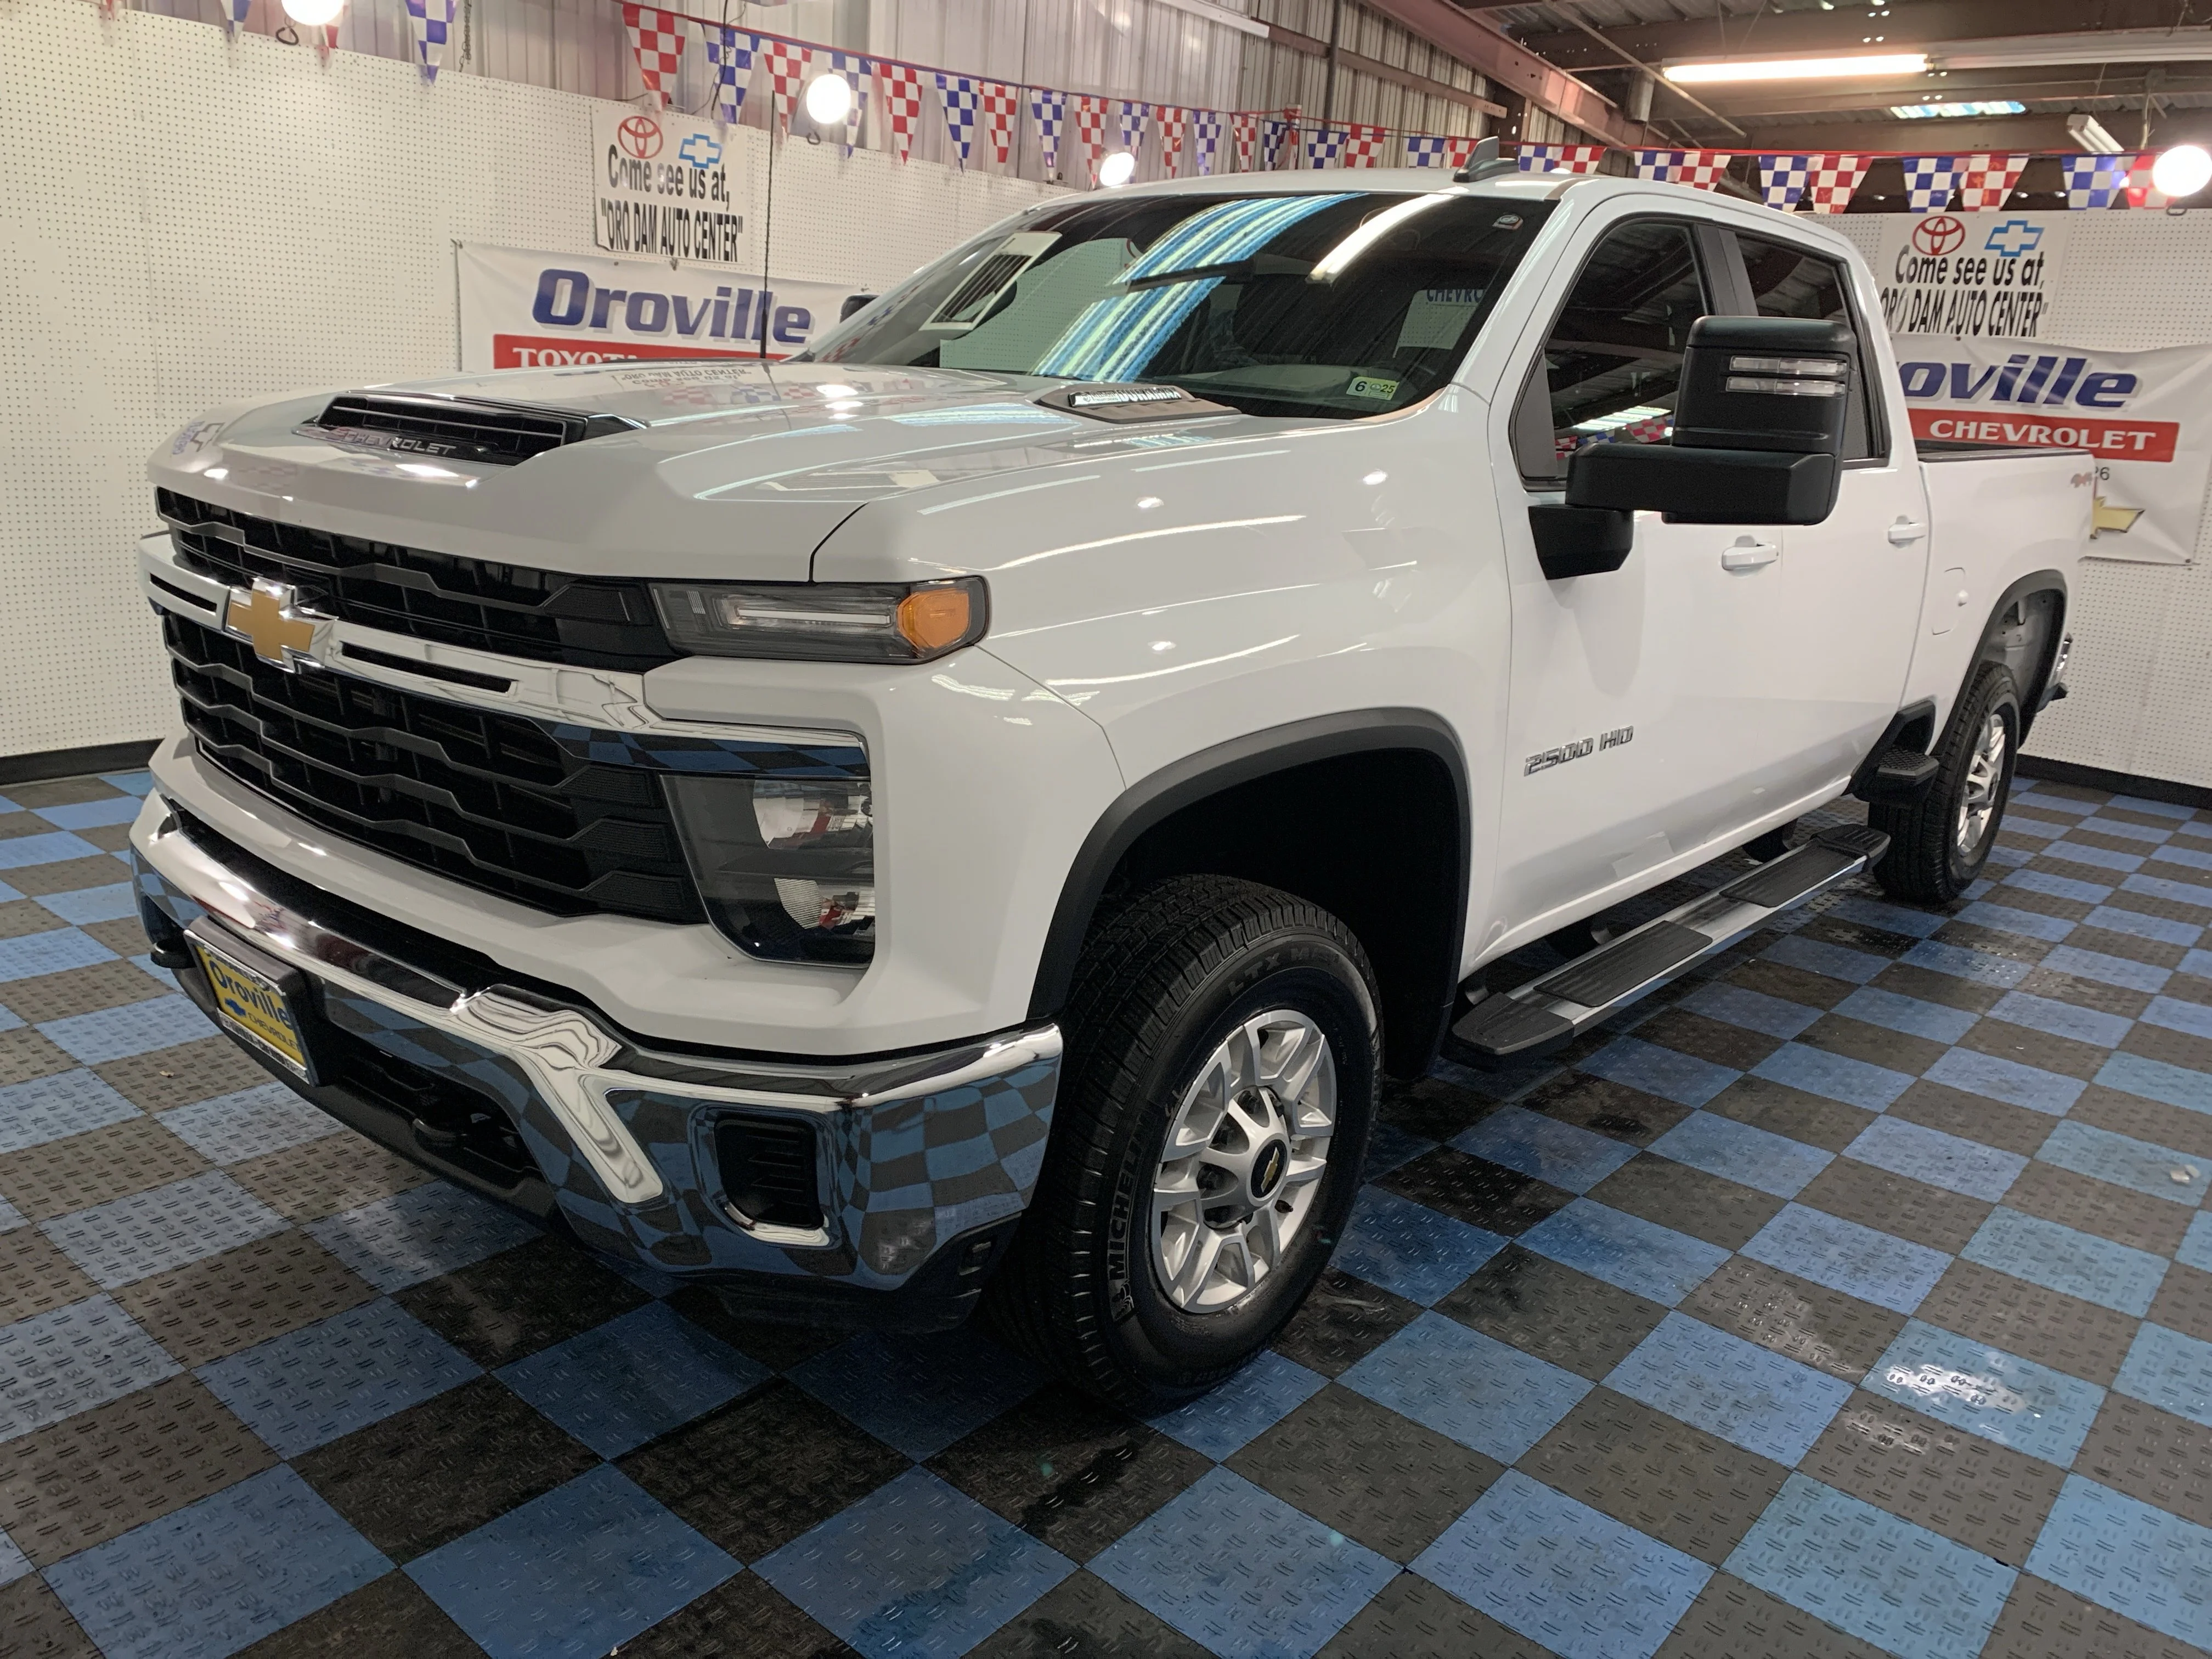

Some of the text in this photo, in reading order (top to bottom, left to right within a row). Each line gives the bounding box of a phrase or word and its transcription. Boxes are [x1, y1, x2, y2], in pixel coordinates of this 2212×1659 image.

[608, 144, 730, 211] Come see us at,
[601, 198, 743, 262] "ORO DAM AUTO CENTER"
[1895, 245, 2045, 289] Come see us at,
[532, 269, 812, 343] Oroville
[1908, 289, 1946, 332] DAM
[1944, 290, 1987, 336] AUTO
[1989, 291, 2049, 337] CENTER"
[512, 347, 637, 368] TOYO
[1116, 387, 1182, 402] DURAMAX
[1355, 381, 1395, 393] 6 25
[1895, 354, 2138, 408] oville
[343, 430, 457, 455] CHEVROLET
[1930, 420, 2156, 451] CHEVROLET
[1524, 725, 1634, 777] 2500 HD
[210, 960, 295, 1030] Oroville
[1227, 952, 1282, 997] LTX
